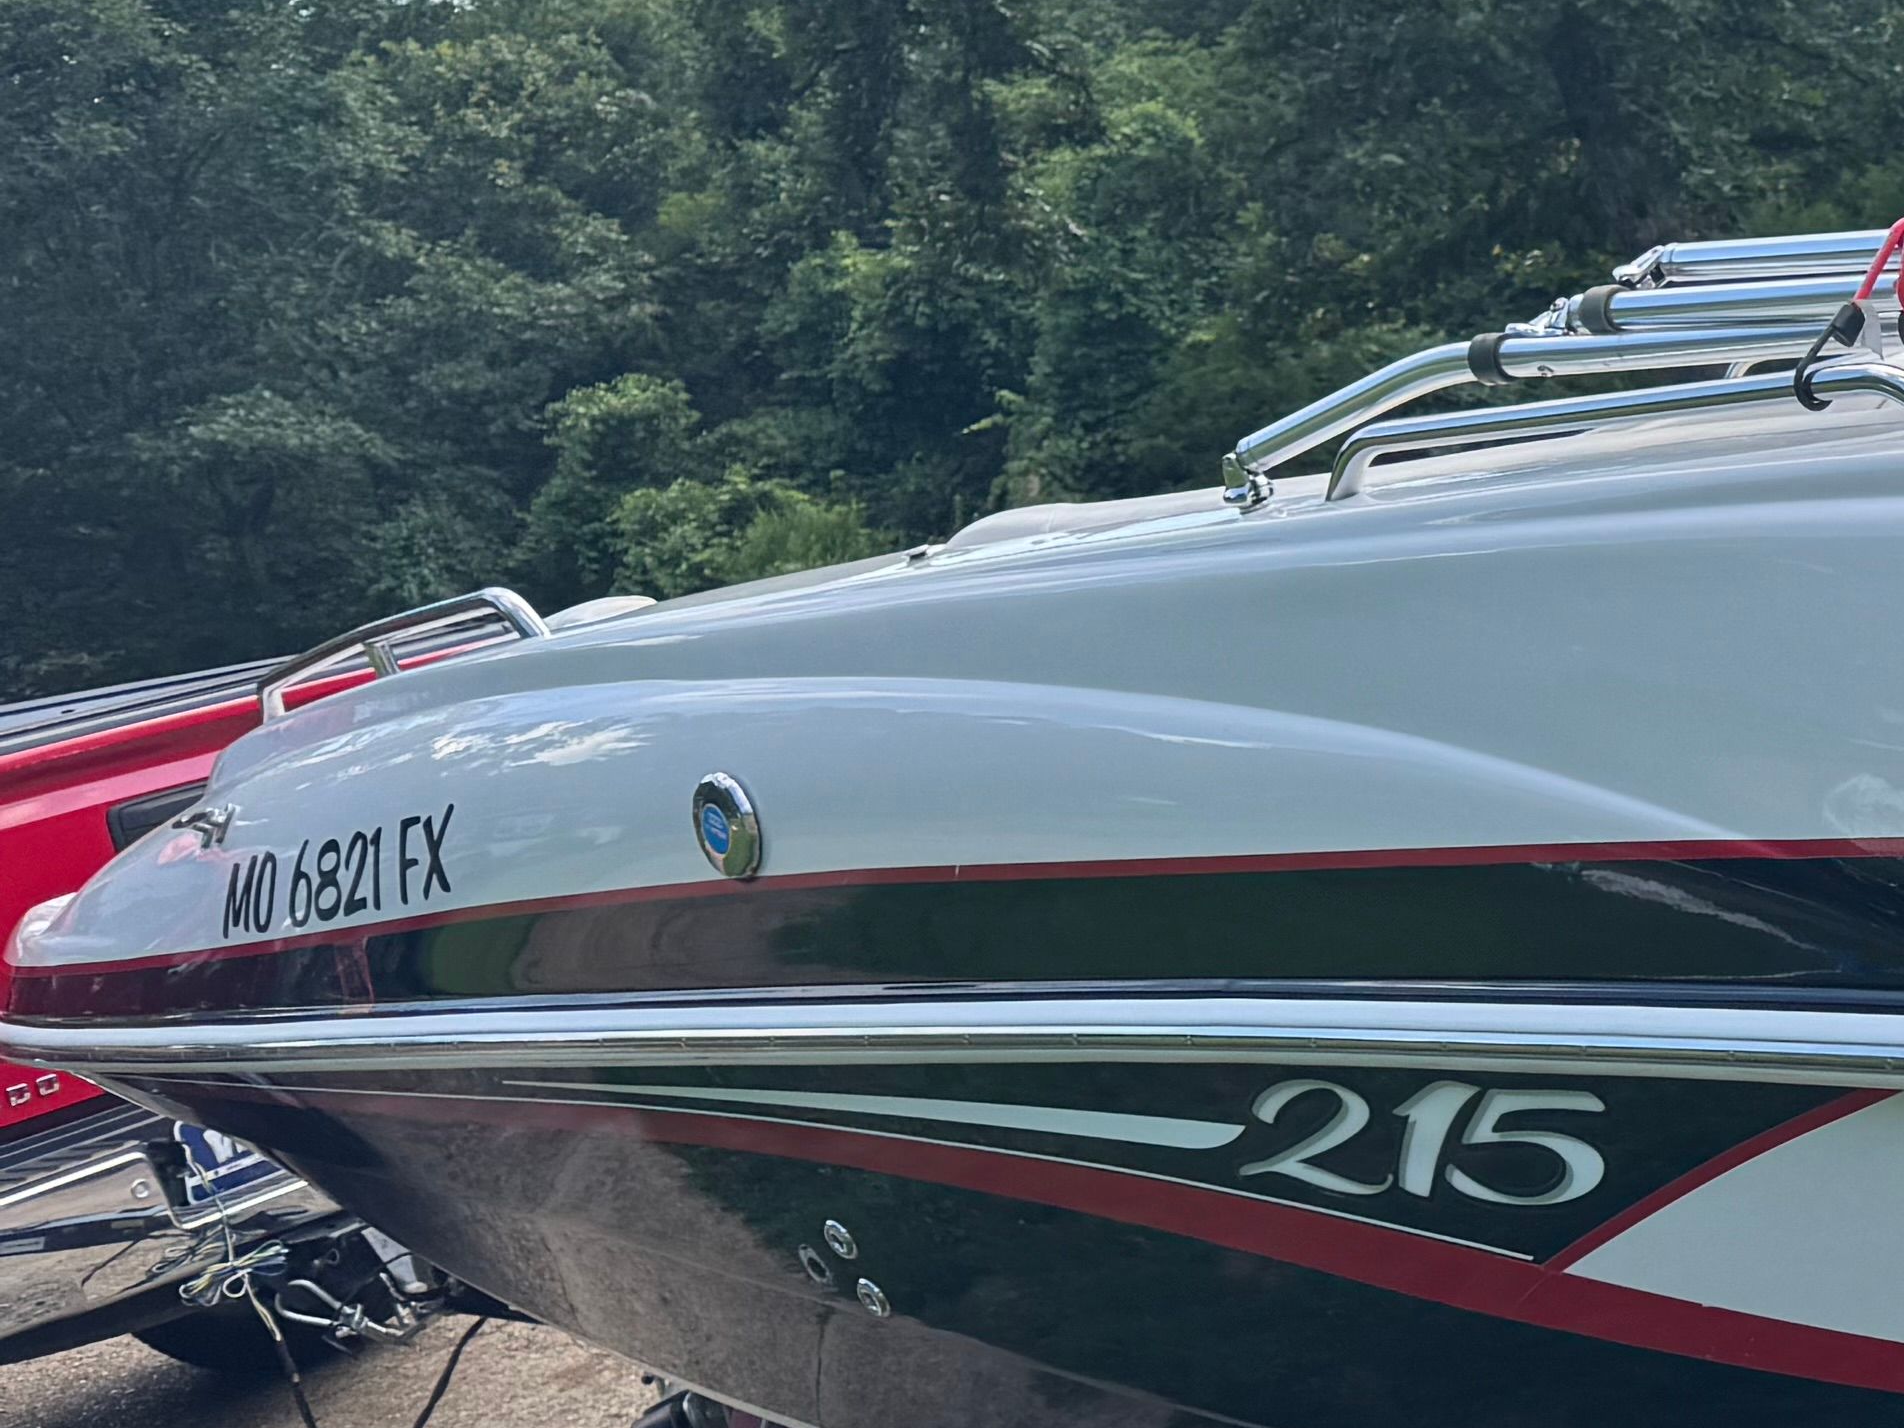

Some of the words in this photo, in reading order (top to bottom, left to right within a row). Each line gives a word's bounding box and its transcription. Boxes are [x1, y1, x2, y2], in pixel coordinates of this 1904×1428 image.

[223, 851, 277, 939] MO
[289, 826, 382, 928] 6821
[399, 803, 455, 907] FX
[1239, 1078, 1606, 1206] 215
